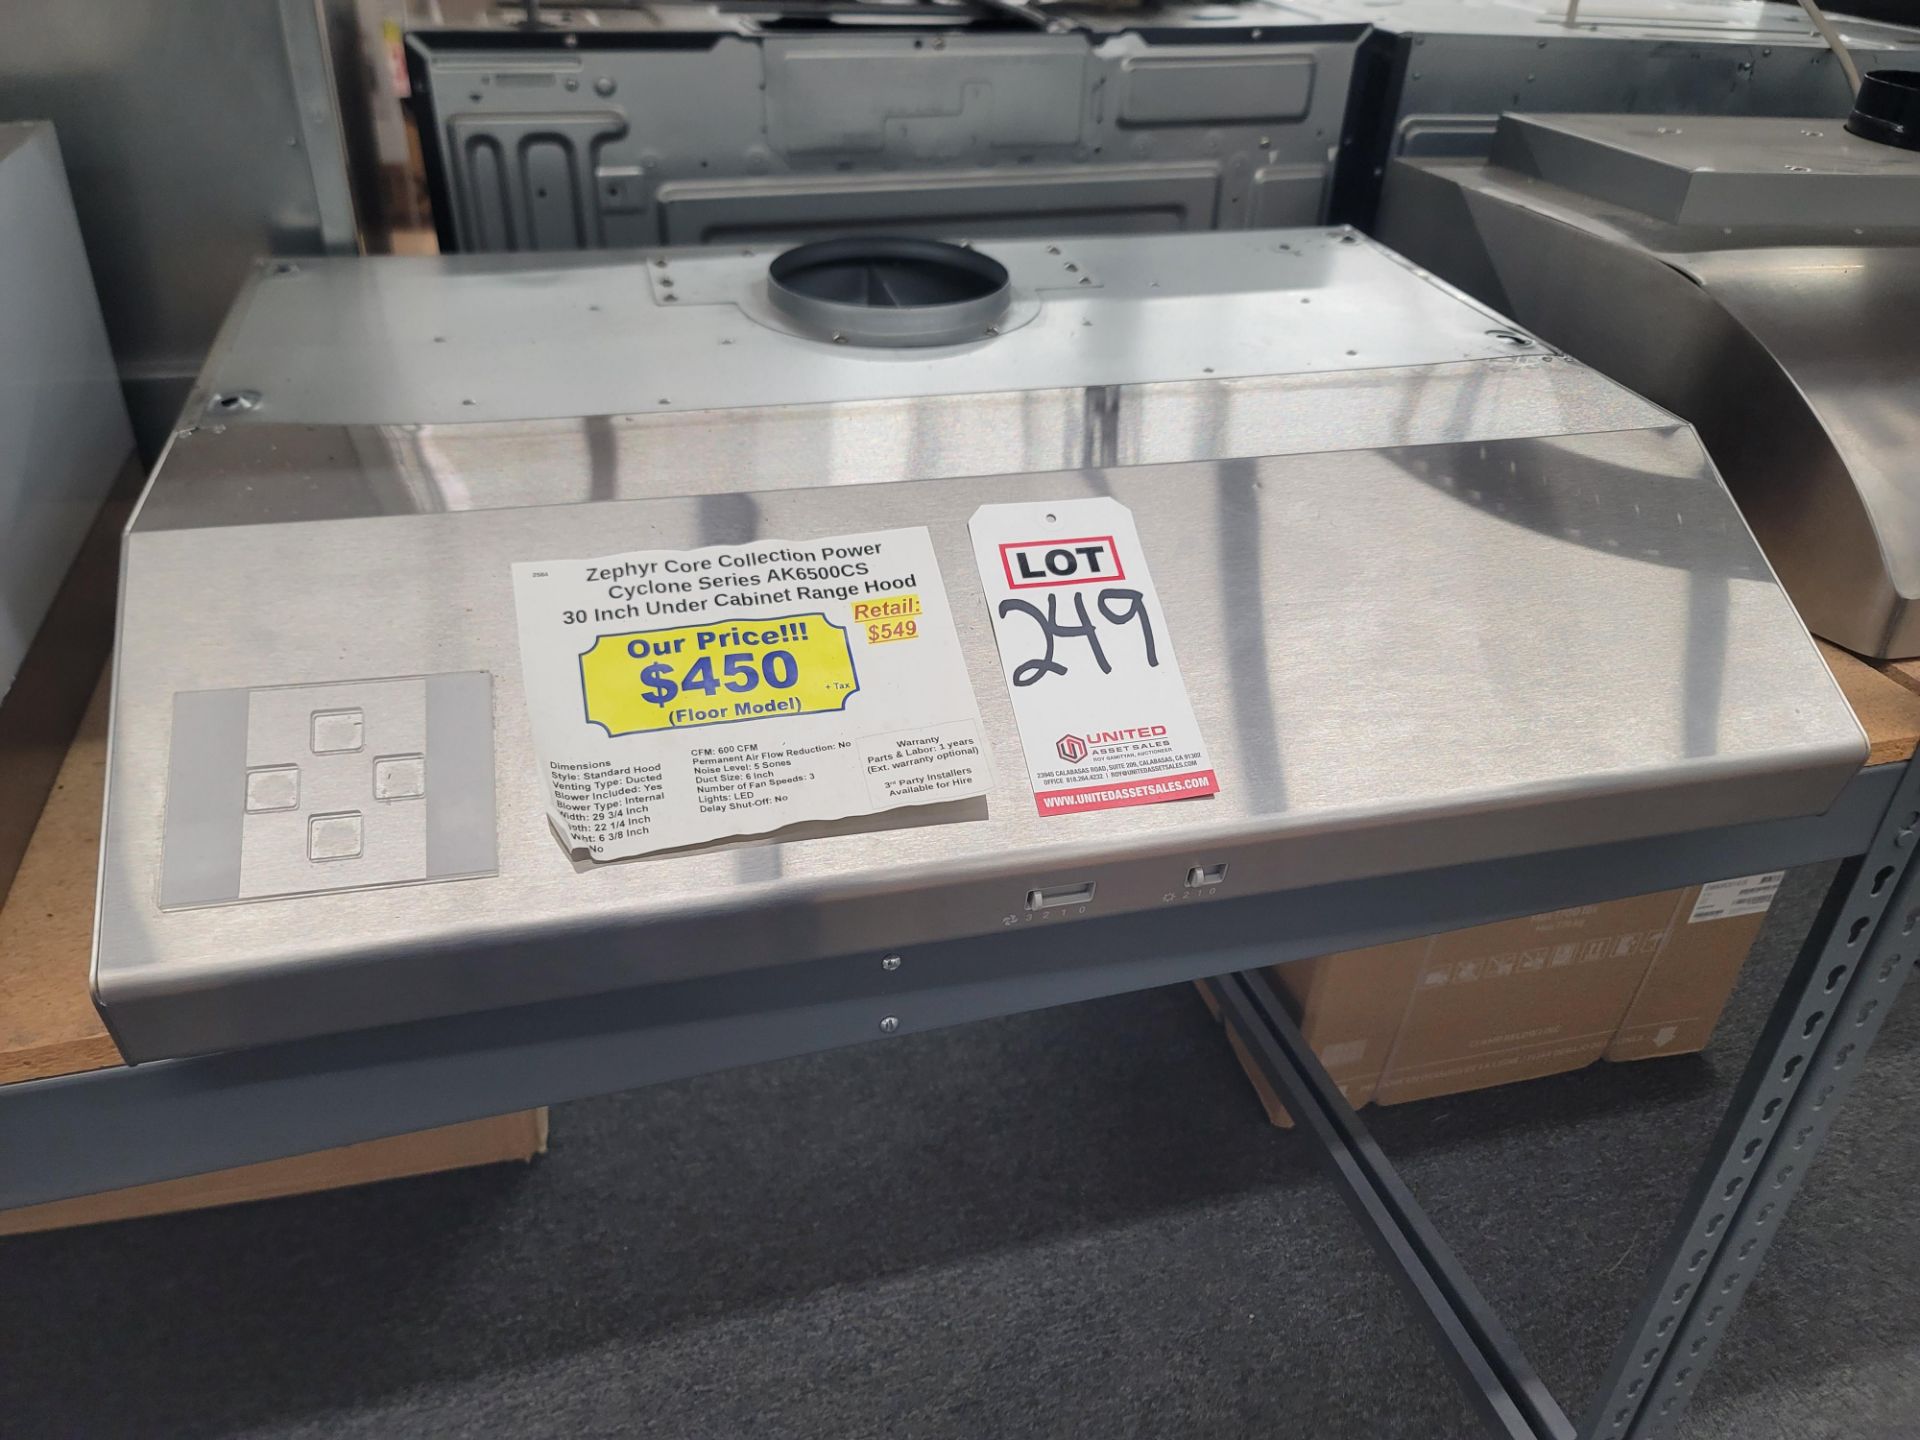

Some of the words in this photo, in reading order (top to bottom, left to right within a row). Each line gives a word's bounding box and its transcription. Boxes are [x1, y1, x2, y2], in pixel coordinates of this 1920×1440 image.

[586, 560, 657, 583] Zephyr
[663, 557, 712, 576] Core
[718, 548, 815, 569] Collection
[822, 542, 882, 561] Power
[1016, 546, 1104, 579] LOT
[609, 579, 692, 600] Cyclone
[699, 572, 761, 591] Series
[767, 562, 869, 583] AK6500CS
[563, 610, 587, 625] 30
[595, 603, 639, 622] Inch
[646, 597, 708, 617] Under
[715, 589, 792, 610] Cabinet
[797, 582, 859, 604] Range
[865, 574, 917, 594] Hood
[854, 598, 921, 621] Retail:
[628, 634, 685, 658] Our
[699, 622, 809, 651] Price!!!
[868, 620, 918, 642] $549
[998, 588, 1159, 686] 249
[640, 649, 798, 708] $450
[834, 682, 850, 690] Tax
[669, 702, 729, 727] (Floor
[735, 697, 801, 718] Model)
[896, 737, 939, 747] Warranty
[1087, 726, 1166, 744] UNITED
[693, 756, 744, 765] Permanent
[786, 744, 835, 756] Reduction:
[718, 746, 734, 754] 600
[737, 744, 758, 752] CFM
[868, 754, 893, 763] Parts
[906, 747, 936, 756] Labor:
[947, 739, 974, 749] years
[1092, 746, 1129, 755] ASSET
[1133, 741, 1170, 750] SALES
[550, 761, 611, 770] Dimensions
[694, 766, 721, 774] Noise
[724, 763, 752, 771] Level:
[762, 760, 791, 768] Sones
[868, 764, 889, 774] (Ext.
[892, 756, 933, 768] warranty
[937, 747, 979, 760] optional)
[1055, 768, 1090, 776] CALABASAS
[1139, 756, 1174, 766] CALABASAS,
[552, 771, 580, 781] Style:
[584, 767, 630, 780] Standard
[634, 764, 661, 773] Hood
[754, 771, 774, 779] Inch
[899, 777, 924, 785] Party
[927, 768, 972, 780] Installers
[553, 781, 591, 791] Venting
[594, 779, 622, 789] Type:
[626, 774, 662, 784] Ducted
[697, 784, 734, 793] Number
[769, 775, 807, 786] Speeds:
[889, 785, 934, 796] Available
[555, 791, 590, 800] Blower
[592, 786, 641, 799] Included:
[557, 800, 591, 810] Blower
[594, 800, 622, 811] Type:
[625, 792, 664, 804] Internal
[699, 794, 731, 804] Lights:
[734, 792, 754, 800] LED
[1044, 777, 1209, 808] WWW.UNITEDASSETSALES.COM
[592, 812, 605, 820] 29
[609, 810, 623, 819] 3/4
[626, 805, 648, 814] Inch
[700, 804, 726, 813] Delay
[729, 799, 772, 810] Shut-Off:
[611, 821, 625, 830] 1/4
[628, 816, 650, 825] Inch
[609, 831, 623, 840] 3/8
[627, 827, 649, 836] Inch
